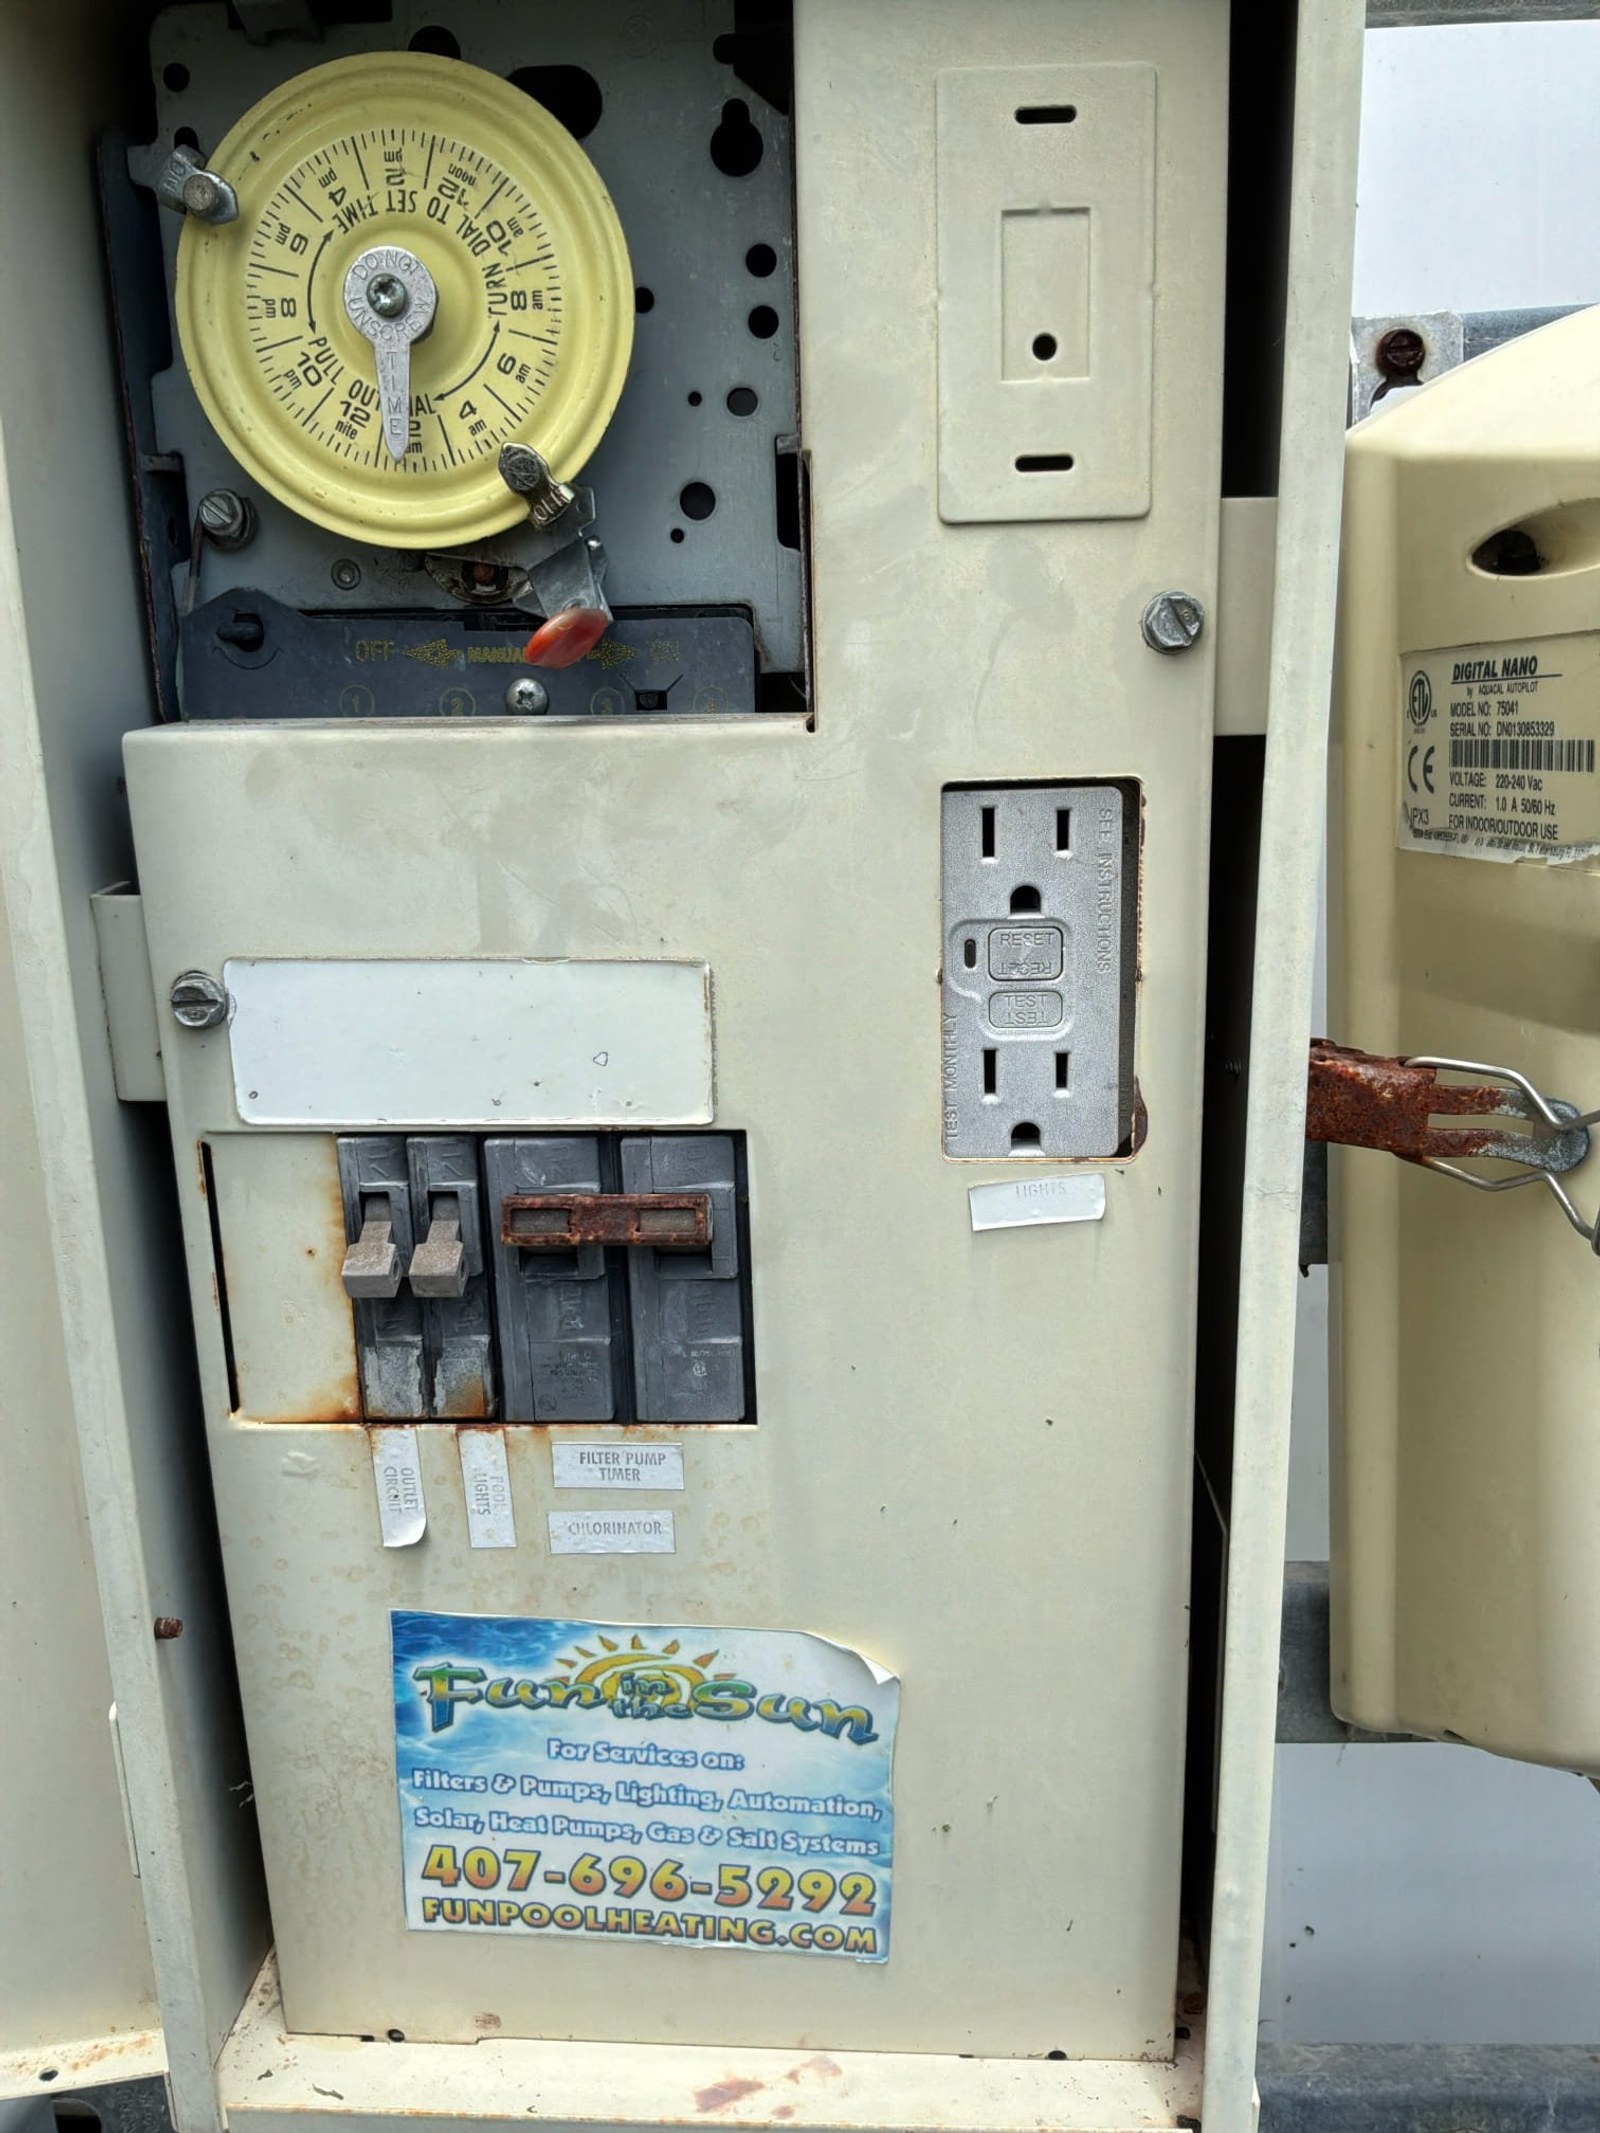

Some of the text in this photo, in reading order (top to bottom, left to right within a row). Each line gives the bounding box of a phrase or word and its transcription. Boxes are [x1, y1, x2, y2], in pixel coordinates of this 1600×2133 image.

[383, 147, 403, 162] pm
[317, 167, 338, 188] pm
[447, 163, 477, 187] noon
[328, 186, 347, 207] 4
[437, 176, 469, 208] 12
[274, 222, 291, 245] pm
[485, 220, 512, 256] 10
[507, 217, 525, 238] am
[289, 232, 309, 256] 6
[332, 189, 508, 318] TURN DIAL TO SET TIME
[352, 253, 379, 280] DO
[262, 298, 276, 319] pm
[281, 298, 297, 319] 8
[510, 290, 527, 311] 8
[531, 290, 543, 310] am
[297, 351, 323, 387] 10
[308, 336, 344, 386] PULL
[496, 352, 517, 375] 6
[283, 369, 302, 390] pm
[515, 363, 532, 384] am
[340, 400, 371, 429] 12
[459, 400, 477, 420] 4
[335, 420, 358, 440] nite
[468, 419, 487, 437] am
[356, 639, 395, 662] OFF
[1453, 655, 1538, 681] DIGITAL NANO
[1478, 682, 1504, 696] AQUACAL
[1506, 681, 1539, 694] AUTOPILOT
[1450, 700, 1519, 717] MODEL NO: 75041
[1450, 721, 1476, 737] SERIAL
[1449, 771, 1543, 792] VOLTAGE: 220-240 Vac
[1449, 793, 1556, 816] CURRENT: 1.0 A 50/60 Hz
[1411, 807, 1430, 826] IPX3
[1449, 814, 1465, 831] FOR
[1465, 815, 1540, 838] INDOOR/OUTDOOR
[1540, 824, 1559, 840] USE
[1097, 850, 1113, 974] INSTRUCTIONS
[1000, 932, 1055, 947] RESET
[1004, 994, 1048, 1008] TEST
[1004, 1011, 1048, 1025] TEST
[943, 1013, 958, 1140] TEST MONTHLY
[1015, 1181, 1067, 1198] LIGHTS
[579, 1451, 667, 1467] FILTER PUMP
[599, 1466, 642, 1482] TIMER
[400, 1466, 418, 1513] OUTLET
[473, 1466, 491, 1516] LIGHTS
[567, 1520, 663, 1536] CHLORINATOR
[412, 1662, 880, 1747] Fun in the Sun
[547, 1738, 745, 1772] For Services on:
[411, 1769, 884, 1821] Filters & Pumps, Lighting, Automation,
[414, 1807, 879, 1858] Solar, Heat Pumps, Gas & Salt Systems
[422, 1844, 877, 1918] 407-696-5292
[422, 1896, 877, 1956] FUNPOOLHEATING.COM
